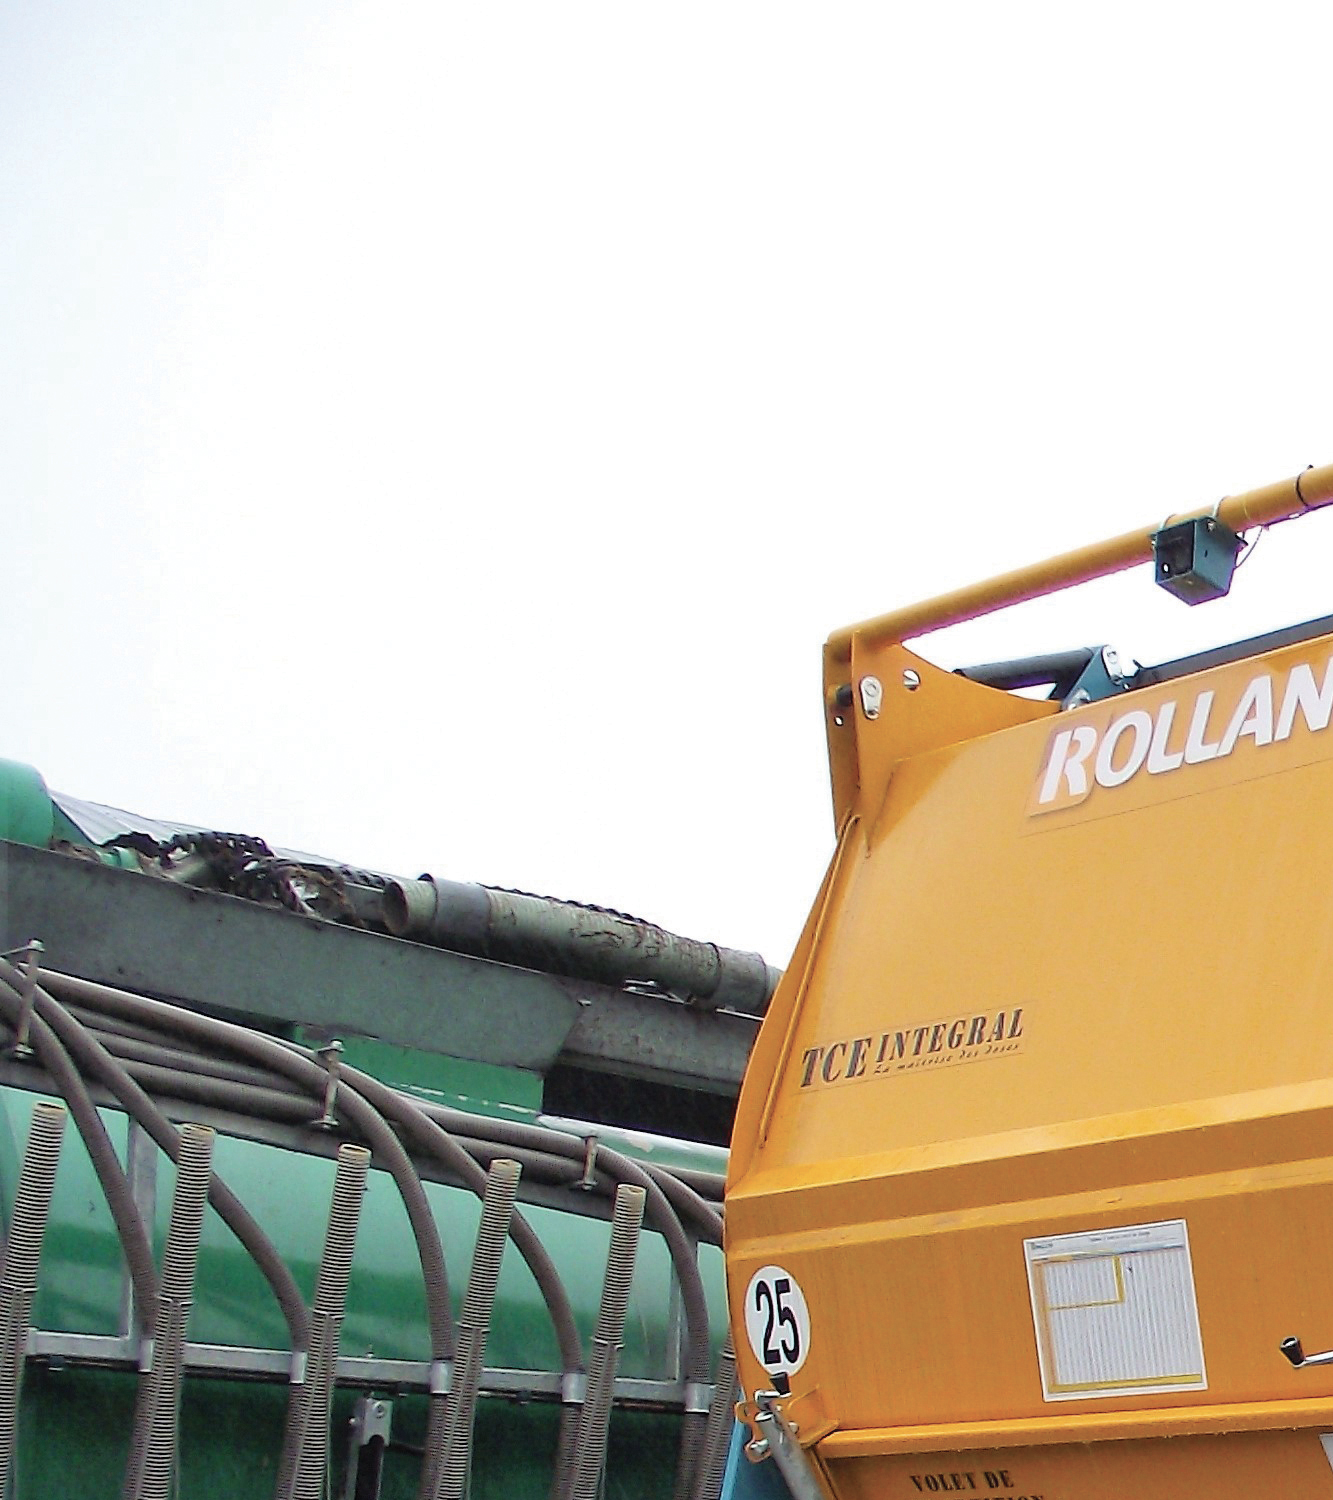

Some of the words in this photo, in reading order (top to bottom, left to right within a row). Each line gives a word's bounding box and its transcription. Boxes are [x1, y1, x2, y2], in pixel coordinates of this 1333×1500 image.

[800, 1037, 872, 1088] TCE
[875, 1007, 1024, 1063] INTEGRAL
[755, 1278, 801, 1365] 25
[910, 1471, 977, 1492] VOLET
[983, 1469, 1014, 1489] DE
